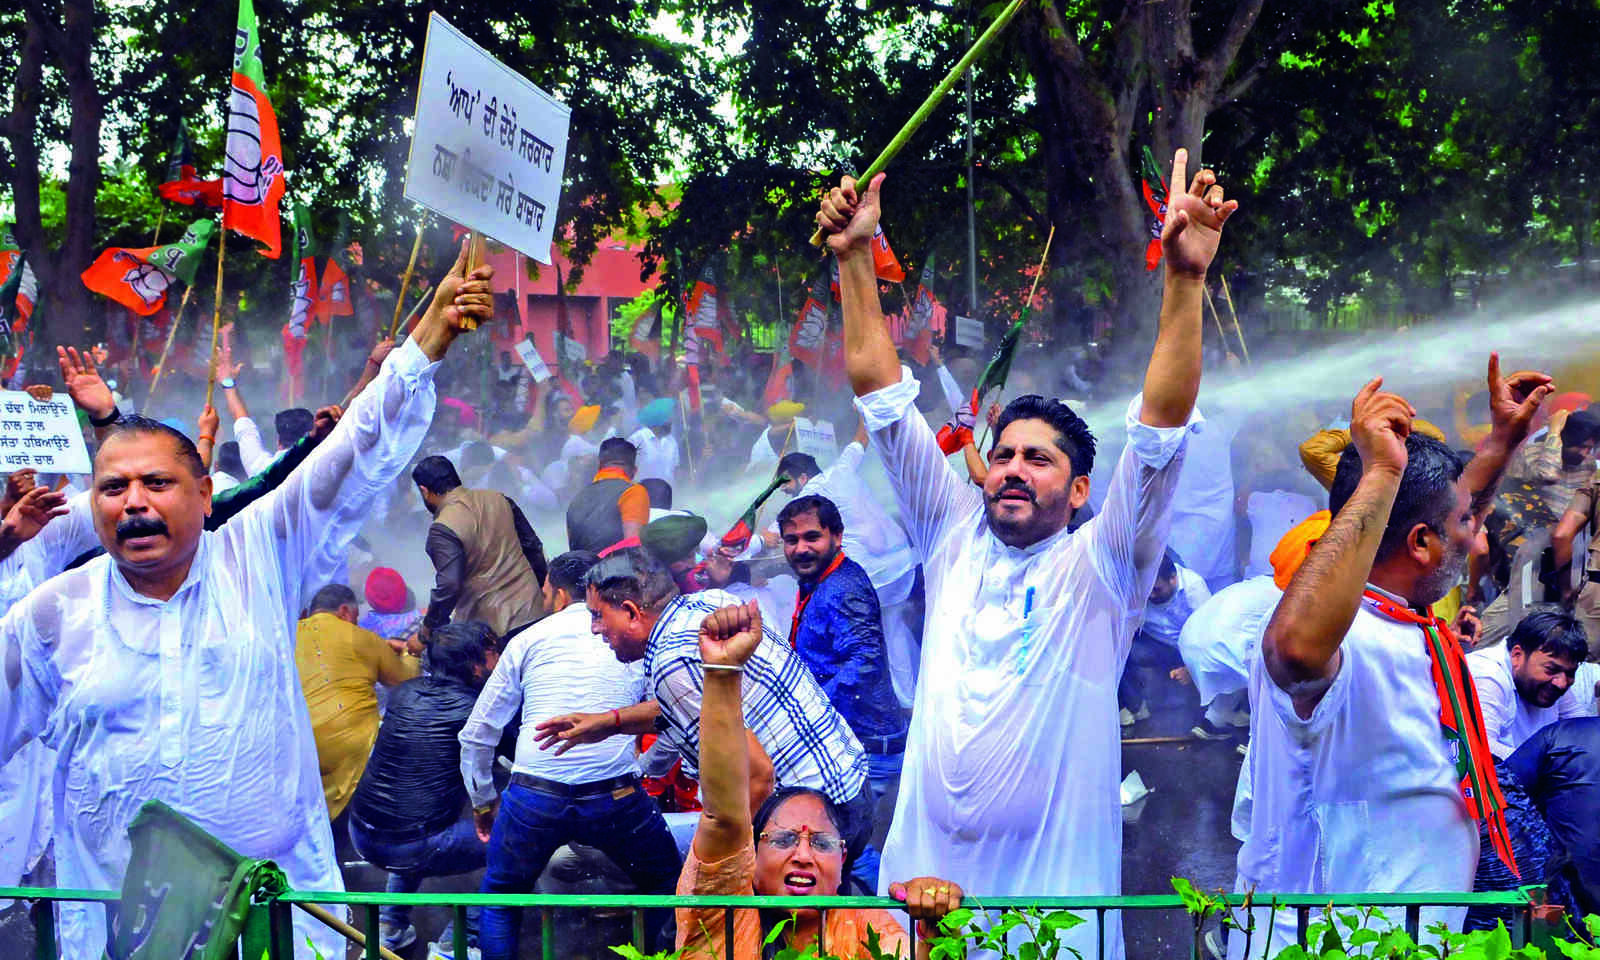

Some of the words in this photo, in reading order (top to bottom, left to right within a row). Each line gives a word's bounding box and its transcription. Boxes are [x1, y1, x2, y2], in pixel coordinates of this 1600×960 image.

[484, 96, 498, 139] ਦੀ
[500, 104, 517, 150] ਦੇਖੋ
[519, 128, 554, 174] ਸਰਕਾਰ
[496, 173, 515, 215] ਸਰੇ
[1, 421, 22, 430] ਨਾਲ
[24, 421, 45, 431] ਤਾਲ
[33, 455, 54, 465] ਚਾਲ
